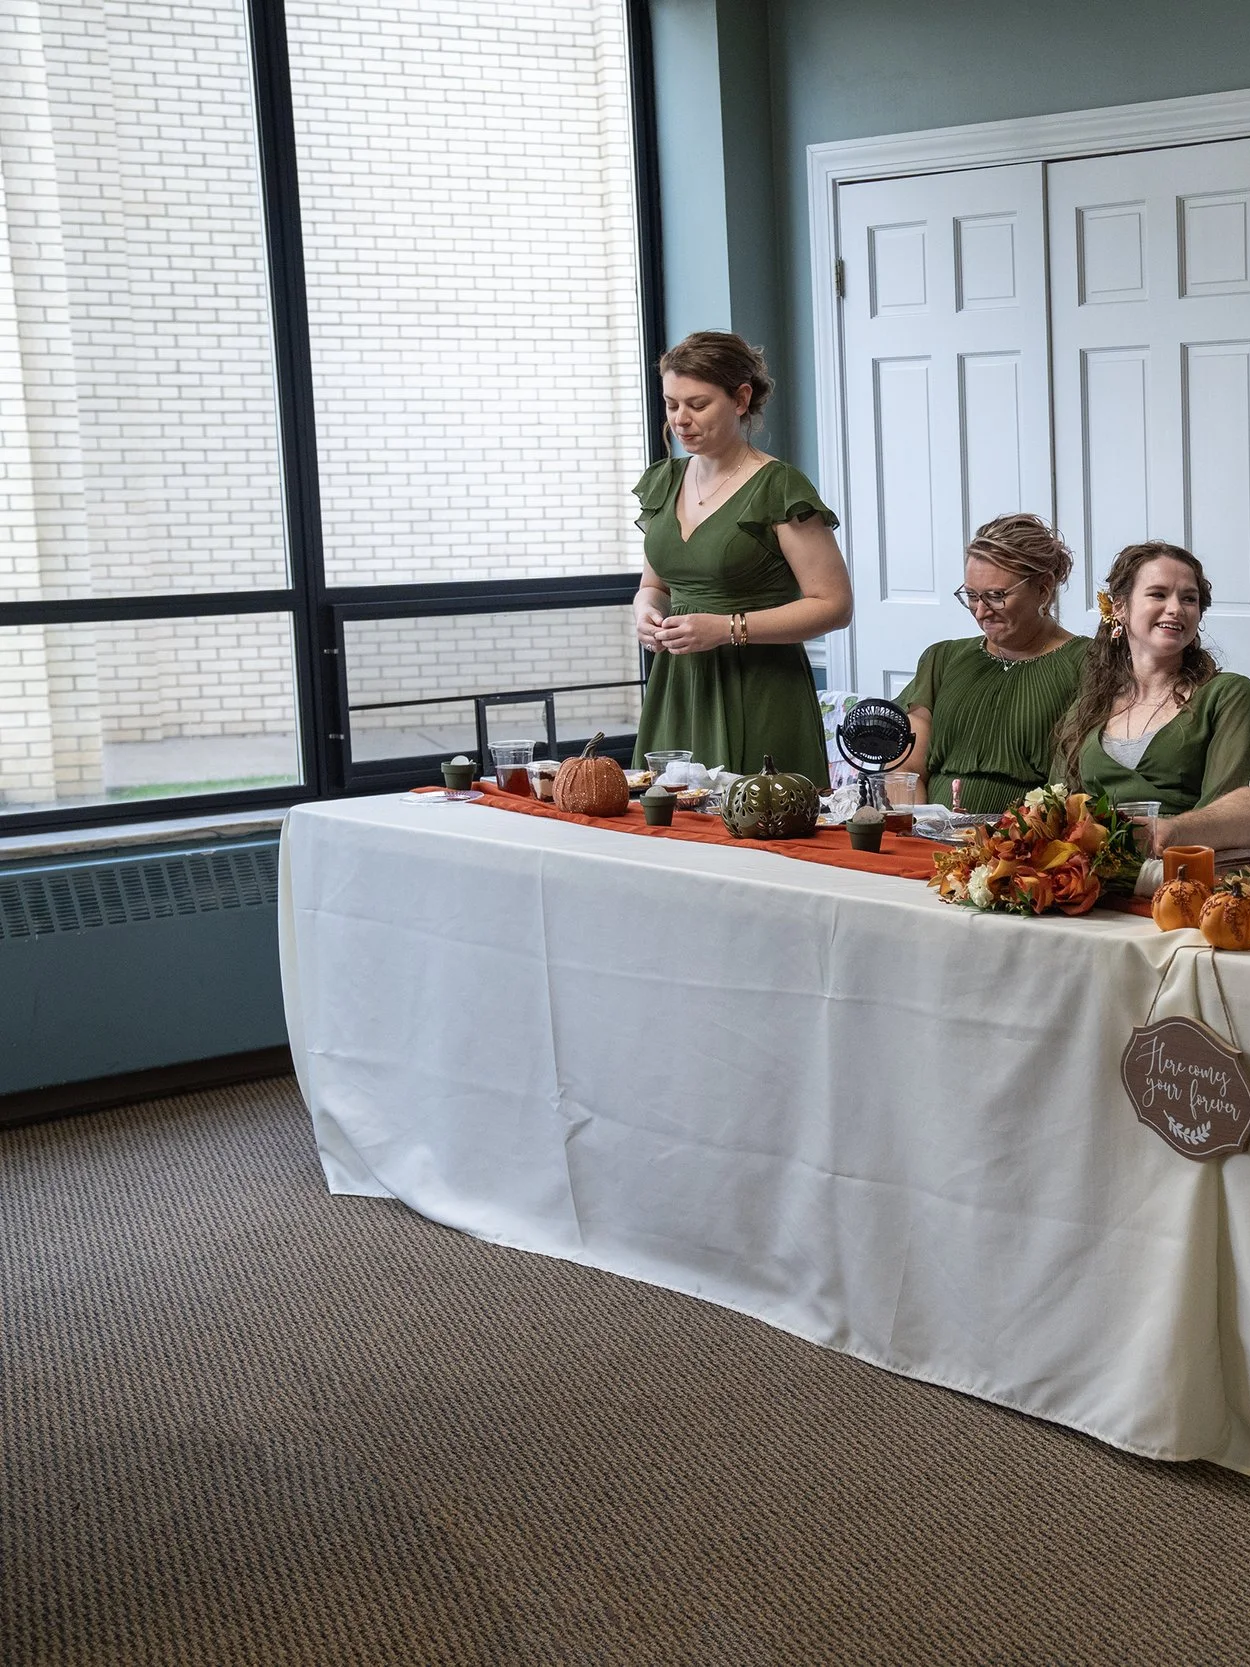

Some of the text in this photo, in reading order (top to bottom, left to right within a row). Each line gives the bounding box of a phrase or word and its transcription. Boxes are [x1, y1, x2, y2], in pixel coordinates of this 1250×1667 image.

[1136, 1036, 1231, 1097] Here comes
[1142, 1077, 1241, 1120] your forever
